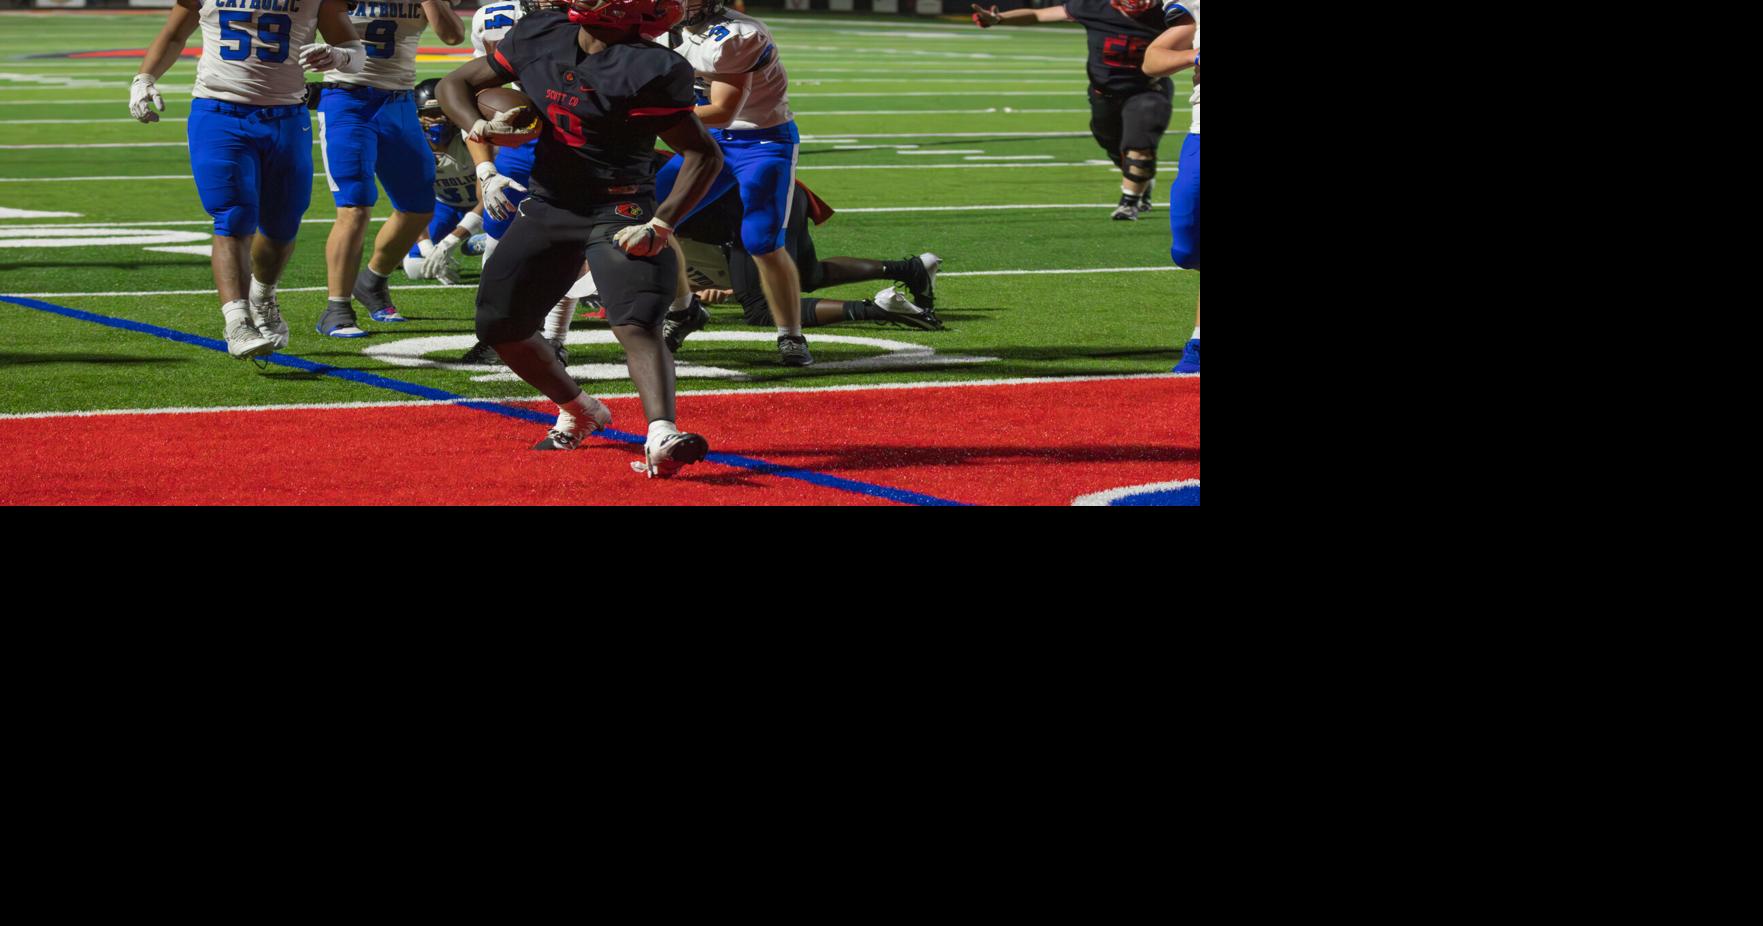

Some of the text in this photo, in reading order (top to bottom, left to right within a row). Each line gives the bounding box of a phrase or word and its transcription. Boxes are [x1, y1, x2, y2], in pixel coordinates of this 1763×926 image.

[484, 5, 515, 30] 14
[218, 10, 292, 63] 59
[365, 20, 397, 59] 9
[545, 88, 568, 102] SCOTT
[436, 174, 477, 188] THOLIC
